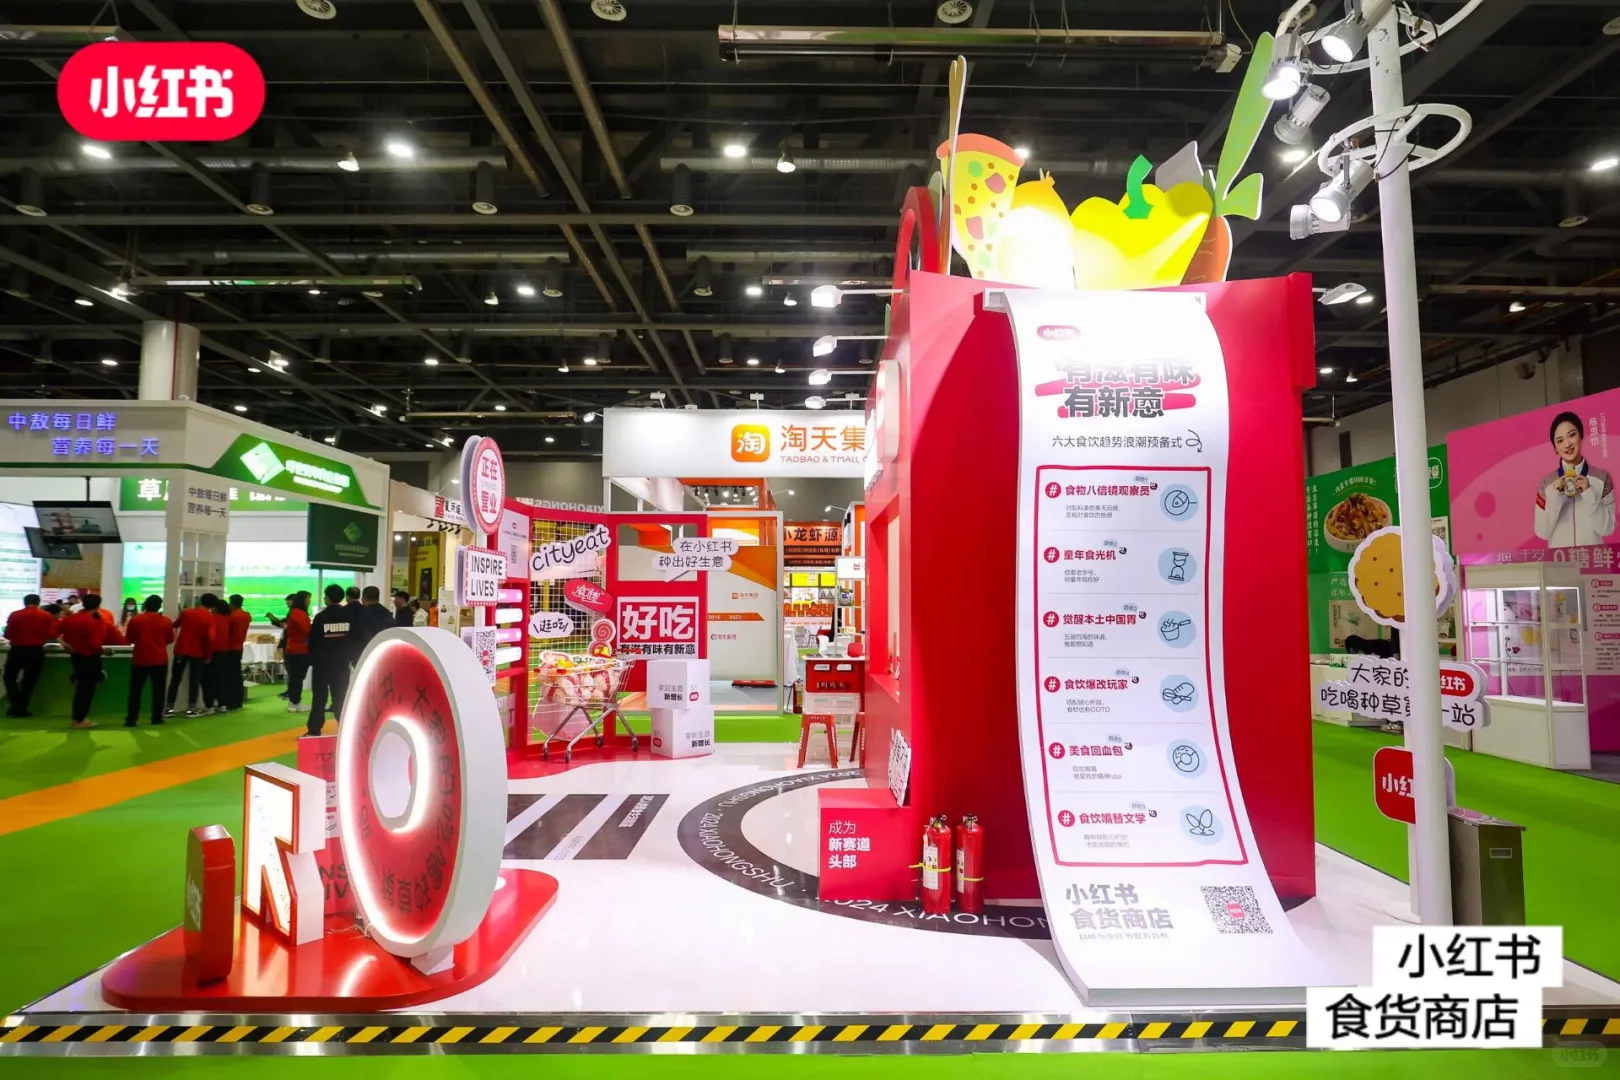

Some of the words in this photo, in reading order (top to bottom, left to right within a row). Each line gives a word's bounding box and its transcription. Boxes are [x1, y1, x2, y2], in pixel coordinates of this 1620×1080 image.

[1064, 386, 1164, 418] 有新意
[8, 412, 117, 431] 中敖每日鲜
[51, 437, 160, 456] 营养每一天
[137, 478, 169, 501] 草
[1065, 485, 1150, 497] 食物八倍镜观察员
[532, 527, 609, 572] cityeat
[680, 540, 732, 553] 在小红书
[659, 555, 724, 568] 种出好生意
[1064, 550, 1116, 561] 童年食光机
[471, 555, 503, 576] INSPIRE
[471, 579, 495, 597] LIVES
[622, 604, 694, 641] 好吃
[1063, 614, 1136, 625] 觉醒本土中国胃
[1064, 679, 1128, 690] 食饮爆改玩家
[1069, 745, 1123, 757] 美食回血包
[1079, 813, 1146, 825] 食饮嘴替文学
[828, 820, 856, 835] 成为
[828, 837, 871, 852] 新赛道
[699, 826, 795, 888] XIAOHONGSHU
[828, 854, 857, 869] 头部
[1065, 883, 1139, 906] 小红书
[1070, 907, 1174, 930] 食货商店
